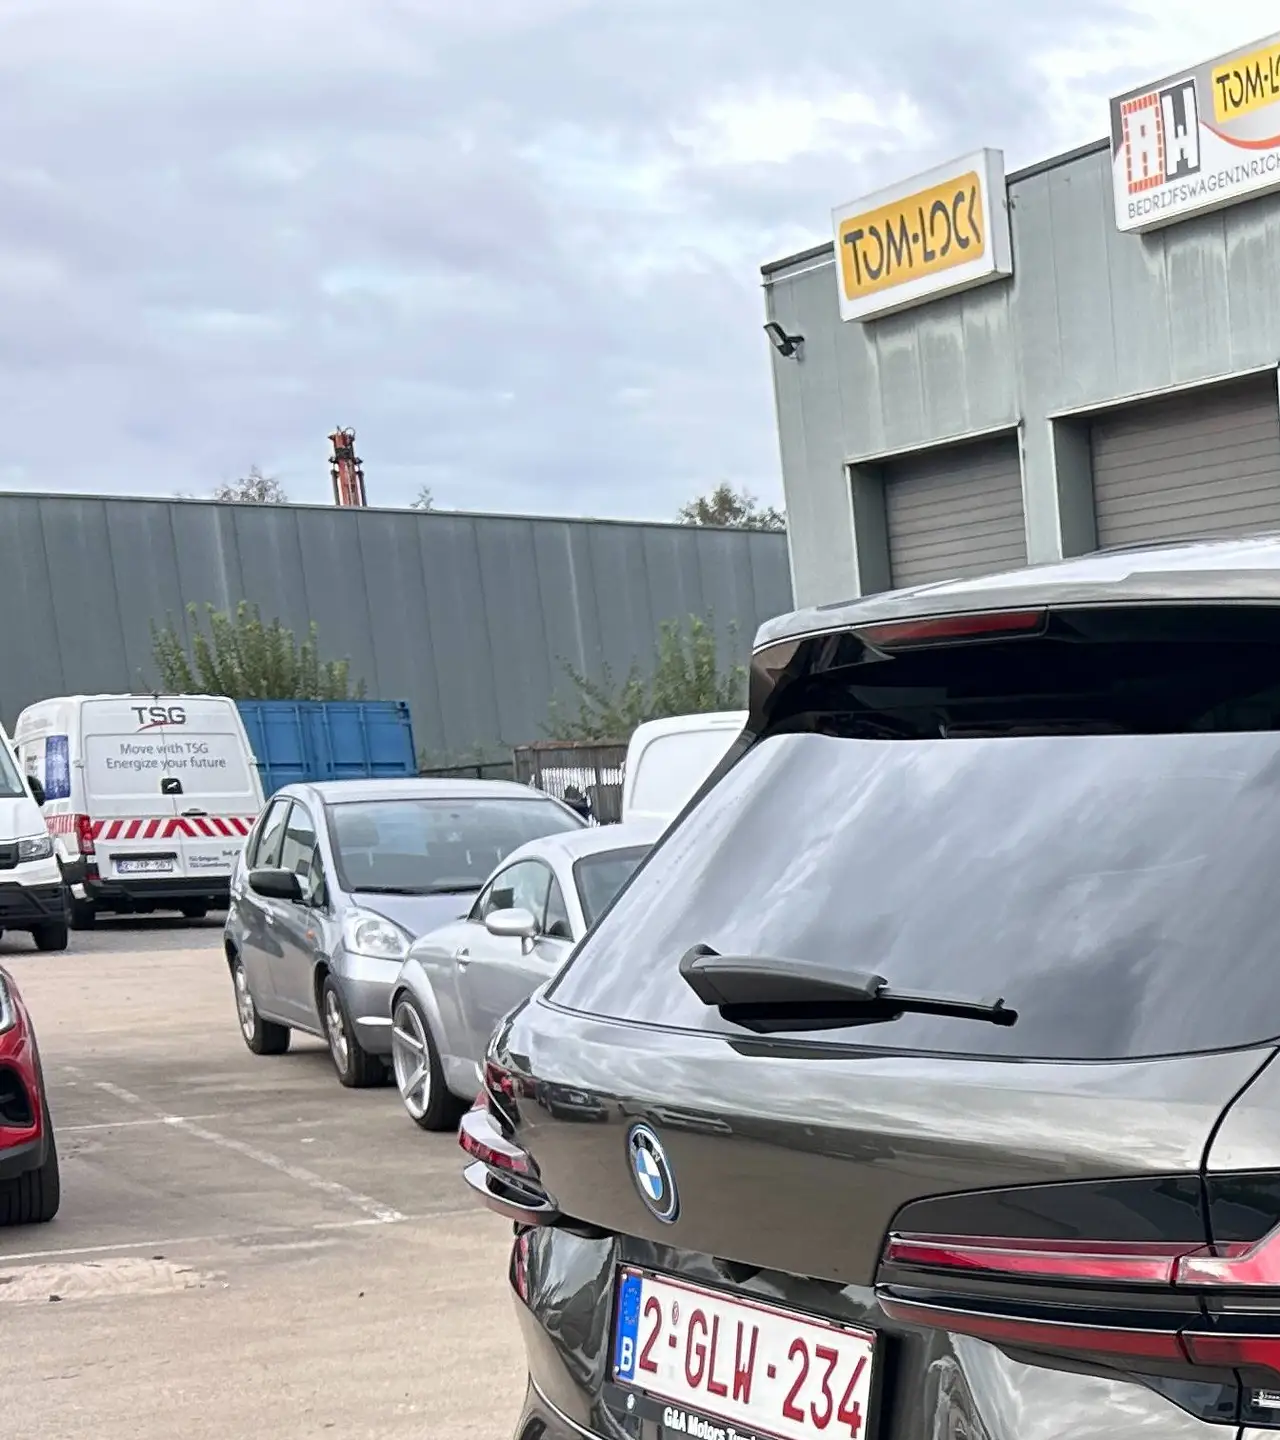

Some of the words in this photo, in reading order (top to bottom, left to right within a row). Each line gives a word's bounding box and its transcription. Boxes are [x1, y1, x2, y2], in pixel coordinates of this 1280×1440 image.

[131, 707, 186, 725] TSG
[120, 744, 154, 755] Move
[157, 742, 184, 754] with
[186, 742, 209, 754] TSG
[106, 758, 158, 771] Energize
[161, 759, 187, 771] your
[190, 756, 226, 768] future
[620, 1336, 633, 1372] B
[639, 1296, 868, 1439] 2-GLW-234
[664, 1406, 686, 1432] G&A
